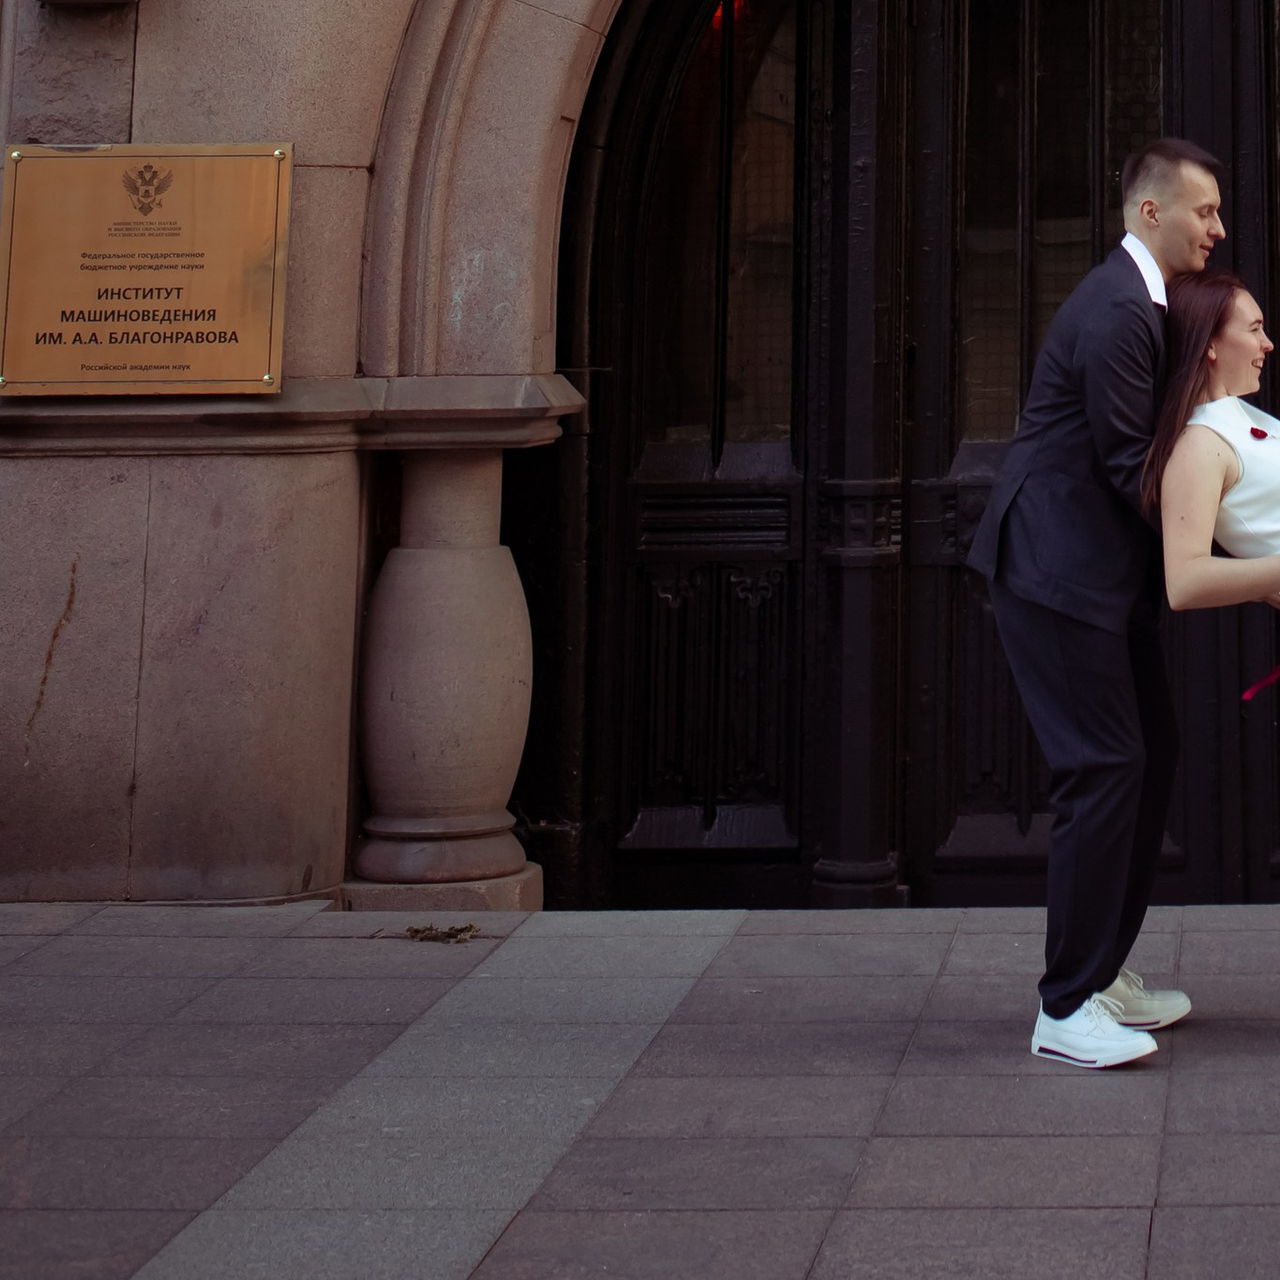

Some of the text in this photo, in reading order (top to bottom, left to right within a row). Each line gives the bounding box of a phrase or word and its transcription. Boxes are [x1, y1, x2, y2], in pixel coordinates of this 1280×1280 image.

[80, 251, 205, 260] Федеральное государственное
[80, 263, 205, 271] бюджетное учреждение науки
[97, 287, 184, 300] ИНСТИТУТ
[60, 309, 217, 324] МАШИНОВЕДЕНИЯ
[35, 331, 239, 345] ИМ. А.А. БЛАГОНРАВОВА
[80, 363, 191, 371] Российской академии наук
